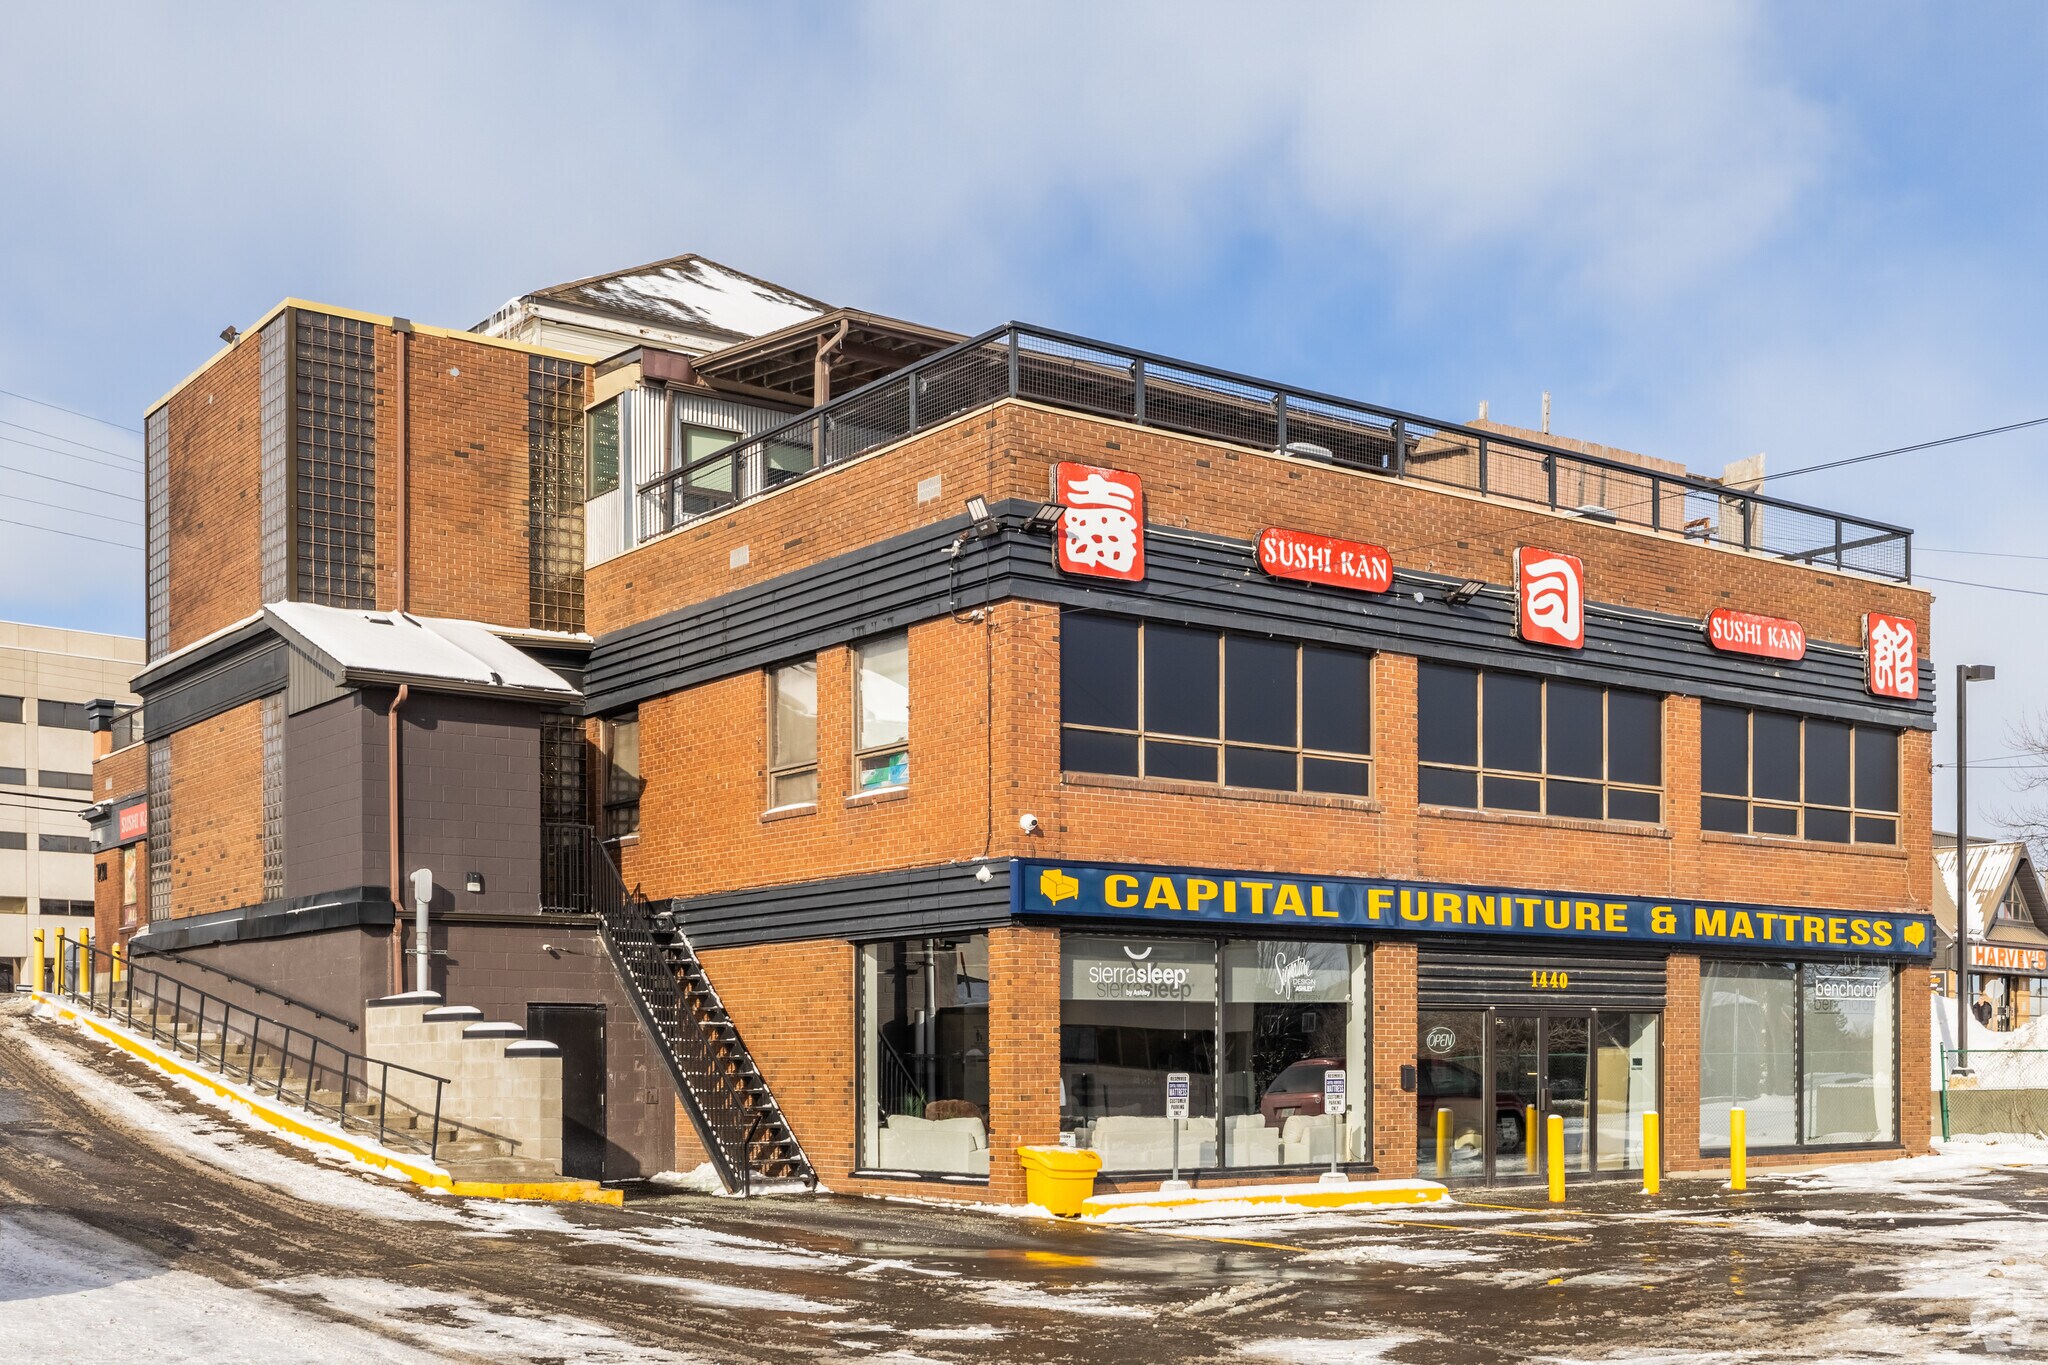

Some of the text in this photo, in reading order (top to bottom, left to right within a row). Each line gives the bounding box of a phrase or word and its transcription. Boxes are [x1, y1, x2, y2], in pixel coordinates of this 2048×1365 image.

[1264, 537, 1388, 582] SUSHI KAN
[1525, 558, 1581, 642] 司
[1712, 616, 1802, 653] SUSHI KAN
[121, 814, 138, 833] SUSHI
[1104, 874, 1893, 947] CAPITAL FURNITURE & MATTRESS
[1975, 945, 2047, 970] HARVEY'S
[1089, 962, 1187, 990] sierrasleep
[1531, 970, 1569, 989] 1440
[1815, 979, 1880, 997] benchcraft
[1428, 1033, 1454, 1047] OPEN
